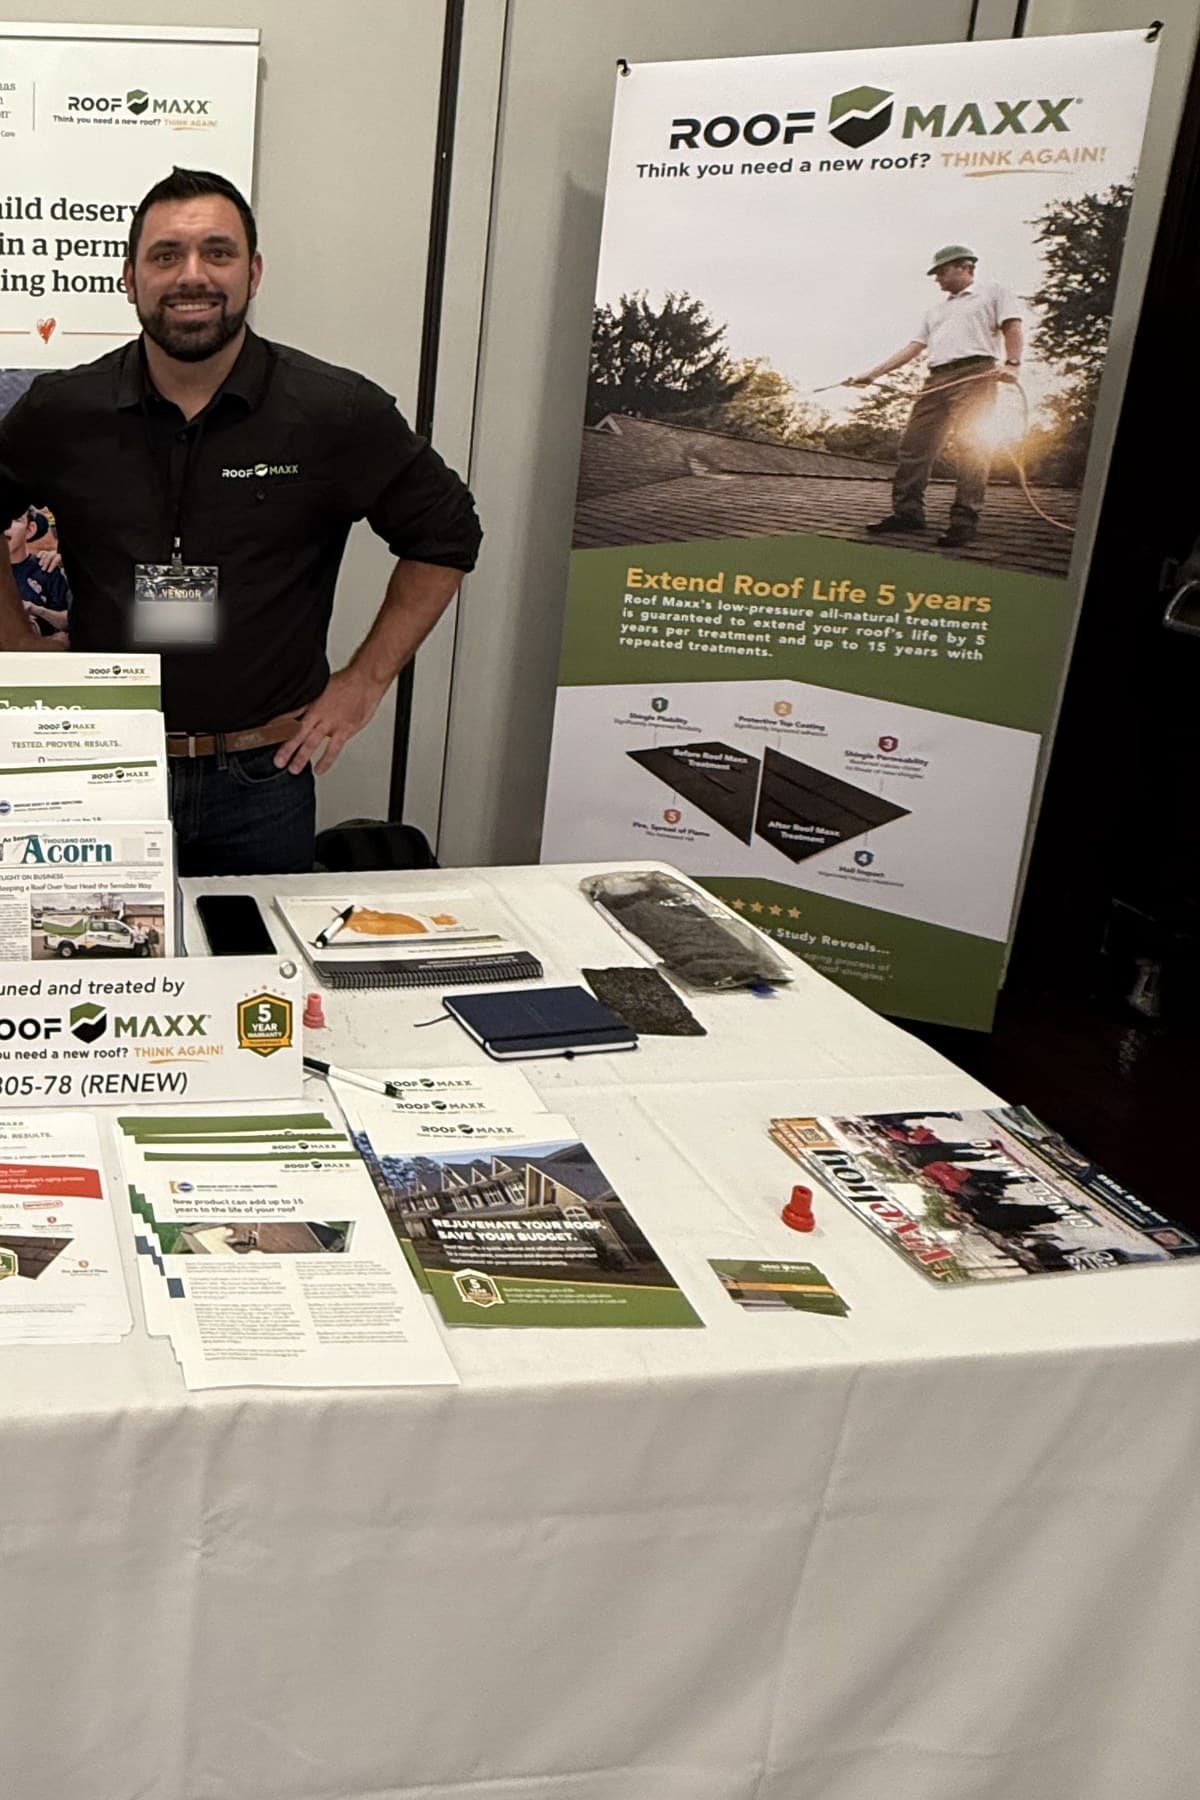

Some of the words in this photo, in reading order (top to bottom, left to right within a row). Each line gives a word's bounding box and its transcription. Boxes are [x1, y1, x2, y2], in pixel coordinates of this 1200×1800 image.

[68, 96, 122, 112] ROOF
[153, 99, 209, 114] MAXX
[53, 115, 74, 123] Think
[77, 116, 92, 125] you
[93, 117, 113, 125] need
[140, 118, 161, 126] roof?
[669, 111, 816, 149] ROOF
[902, 97, 1076, 139] MAXX
[636, 162, 690, 178] Think
[696, 163, 734, 179] you
[741, 158, 793, 175] need
[800, 161, 812, 173] a
[819, 158, 863, 171] new
[870, 153, 931, 170] roof?
[941, 149, 1013, 168] THINK
[1018, 146, 1107, 165] AGAIN!
[31, 239, 49, 256] a
[222, 469, 253, 478] ROOF
[270, 464, 299, 475] MAXX
[162, 588, 202, 599] VENDOR
[626, 568, 725, 593] Extend
[734, 575, 804, 599] Roof
[812, 580, 867, 604] Life
[877, 584, 896, 606] 5
[904, 591, 992, 613] years
[624, 594, 657, 606] Roof
[662, 596, 712, 610] Maxx's
[718, 600, 814, 617] low-pressure
[820, 608, 899, 625] all-natural
[906, 615, 988, 631] treatment
[622, 608, 634, 618] is
[640, 611, 722, 626] guaranteed
[730, 617, 746, 627] to
[753, 619, 806, 631] extend
[813, 624, 848, 635] your
[856, 626, 903, 640] roof's
[911, 630, 938, 643] life
[947, 632, 967, 647] by
[975, 634, 986, 646] 5
[619, 636, 683, 651] repeated
[688, 641, 774, 657] treatments.
[621, 623, 659, 634] years
[666, 626, 691, 638] per
[698, 628, 770, 643] treatment
[779, 635, 806, 646] and
[814, 638, 834, 650] up
[842, 640, 859, 650] to
[868, 641, 887, 653] 15
[894, 645, 939, 657] years
[947, 649, 983, 661] with
[11, 741, 43, 749] TESTED.
[46, 741, 81, 749] PROVEN.
[84, 740, 122, 749] RESULTS.
[20, 835, 113, 864] Acorn
[33, 873, 64, 881] BUSINESS
[776, 928, 817, 945] Study
[821, 935, 891, 954] Reveals...
[47, 978, 82, 996] and
[88, 977, 157, 995] treated
[162, 977, 185, 997] by
[258, 1004, 271, 1022] 5
[114, 1014, 209, 1039] MAXX
[251, 1023, 278, 1032] YEAR
[14, 1049, 48, 1060] need
[51, 1052, 59, 1060] a
[63, 1050, 90, 1060] new
[94, 1047, 129, 1059] roof?
[134, 1046, 173, 1058] THINK
[177, 1045, 224, 1057] AGAIN!
[81, 1072, 188, 1097] (RENEW)
[174, 1206, 198, 1215] years
[200, 1206, 209, 1214] to
[211, 1206, 226, 1214] the
[256, 1206, 275, 1215] your
[277, 1205, 297, 1213] roof
[195, 1198, 229, 1207] product
[250, 1198, 266, 1206] add
[268, 1199, 279, 1207] up
[432, 1219, 521, 1230] REJUVENATE
[525, 1220, 561, 1230] YOUR
[564, 1220, 607, 1230] ROOF.
[437, 1231, 475, 1240] SAVE
[476, 1232, 515, 1241] YOUR
[518, 1232, 578, 1242] BUDGET.
[470, 1278, 481, 1289] 5
